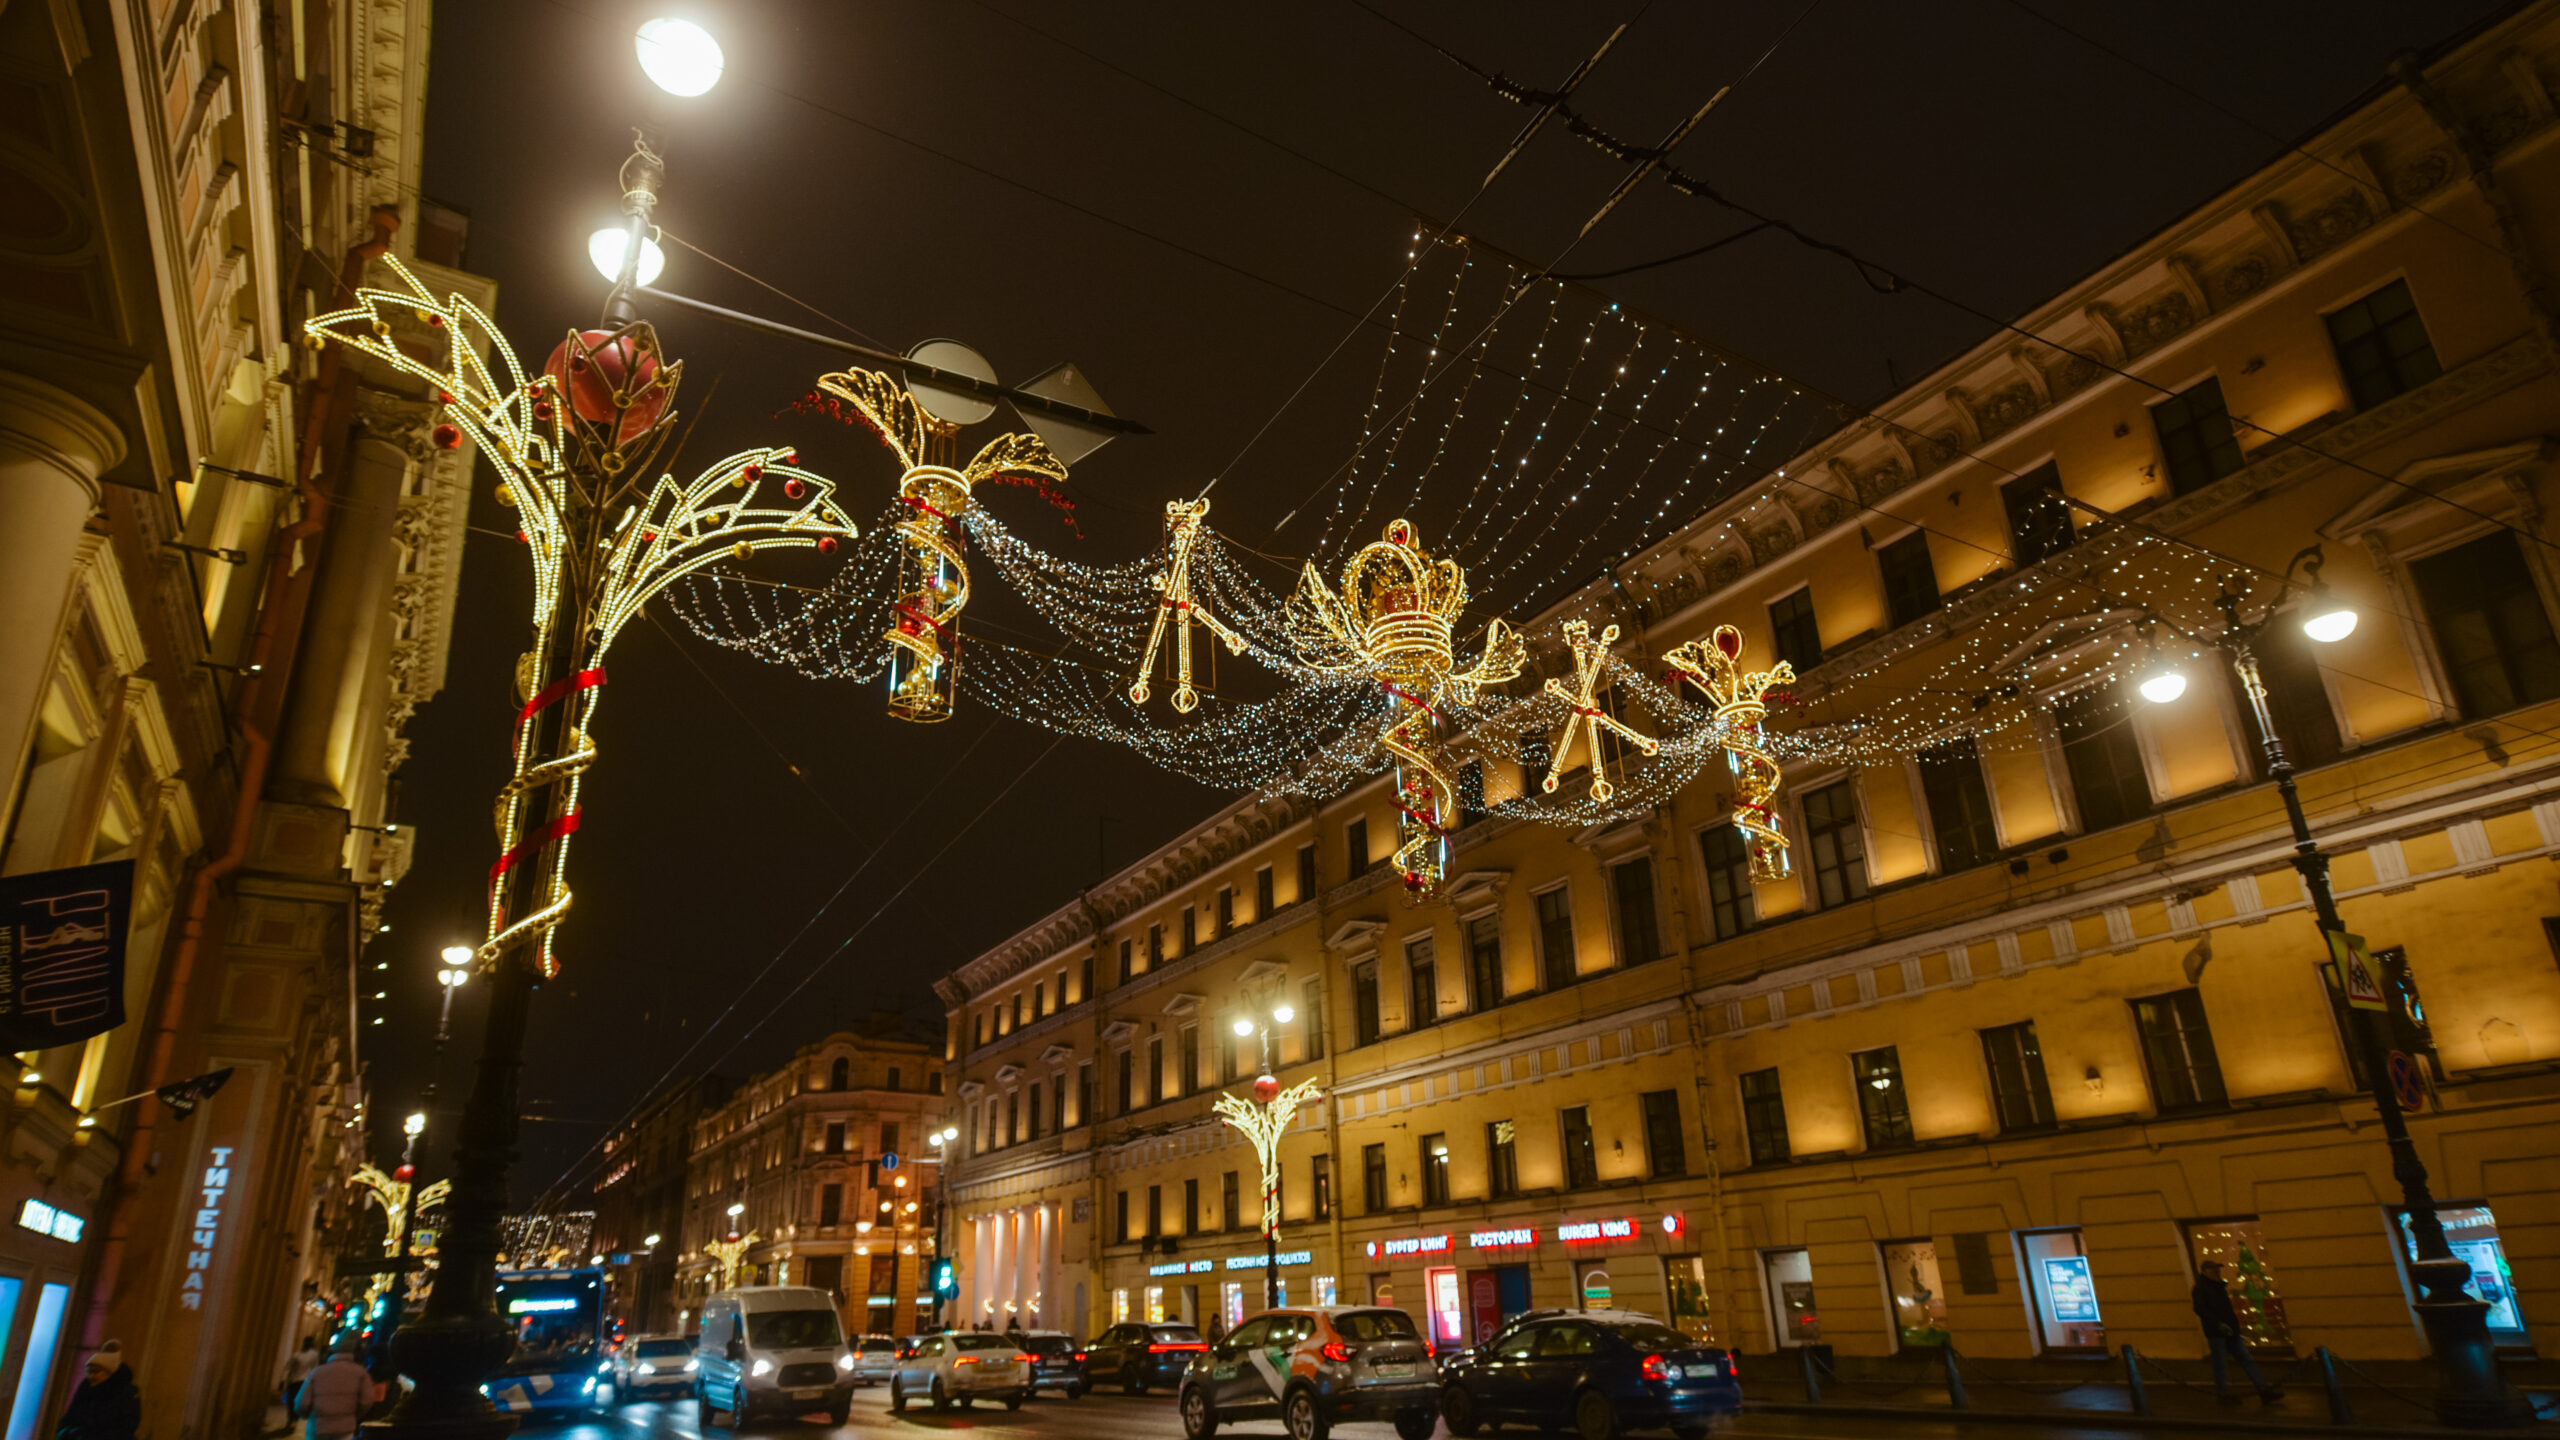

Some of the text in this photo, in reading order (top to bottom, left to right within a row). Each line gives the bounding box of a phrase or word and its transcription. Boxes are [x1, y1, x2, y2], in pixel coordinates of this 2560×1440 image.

[180, 1146, 234, 1311] ТИТЕЧНАЯ
[1470, 1229, 1533, 1247] РЕСТОРАН
[1558, 1220, 1631, 1240] BURGER KING
[1385, 1235, 1449, 1254] БУРГЕР КИНГ
